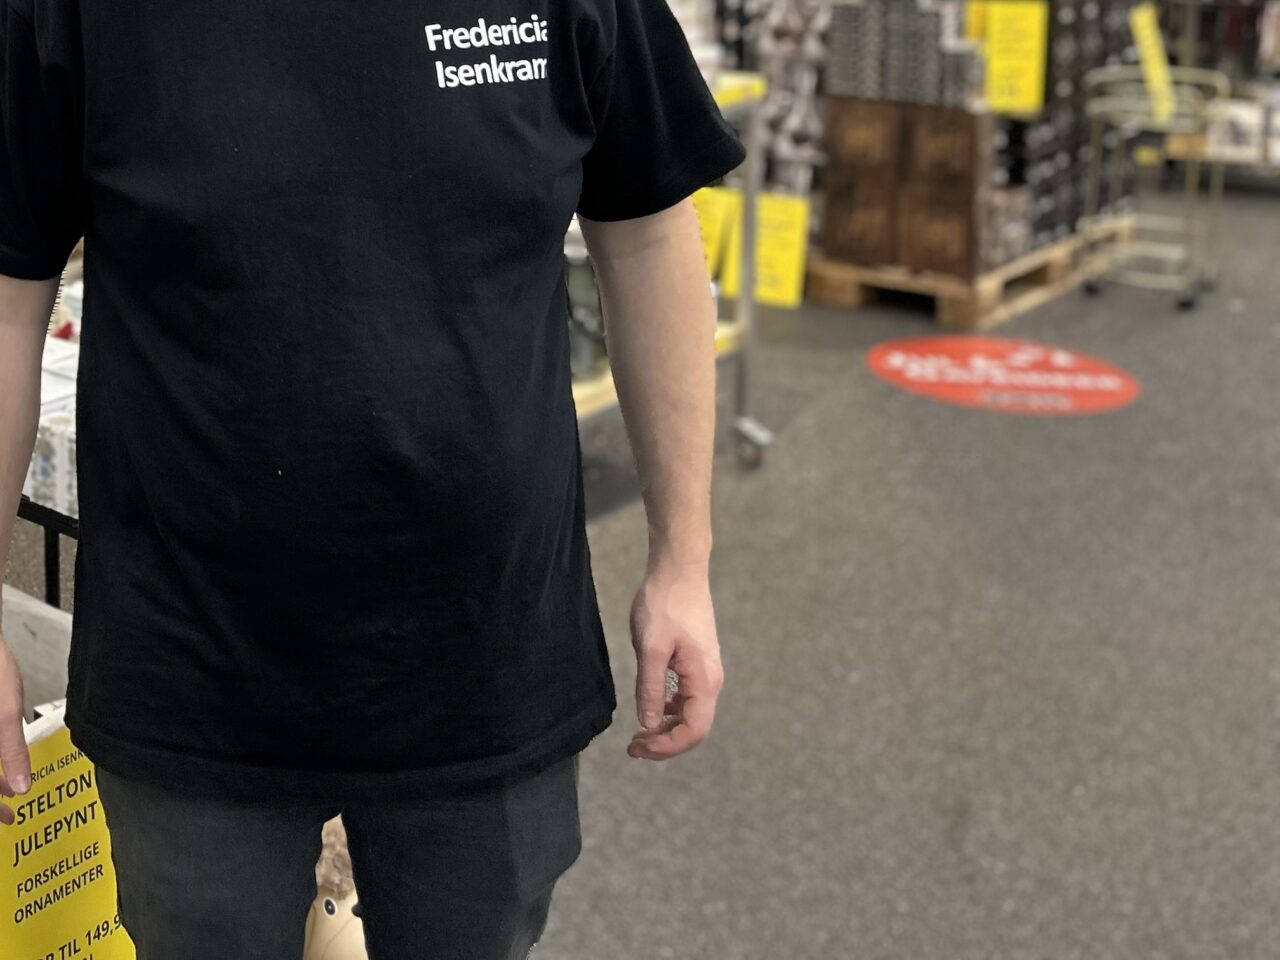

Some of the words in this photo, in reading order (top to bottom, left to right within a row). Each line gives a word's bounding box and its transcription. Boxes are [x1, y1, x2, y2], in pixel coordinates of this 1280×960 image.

[17, 770, 92, 825] STELTON
[13, 801, 97, 867] JULEPYNT
[14, 864, 104, 924] ORNAMENTER
[17, 842, 99, 897] FORSKELLIGE
[58, 938, 80, 960] TIL
[85, 913, 121, 946] 149,9
